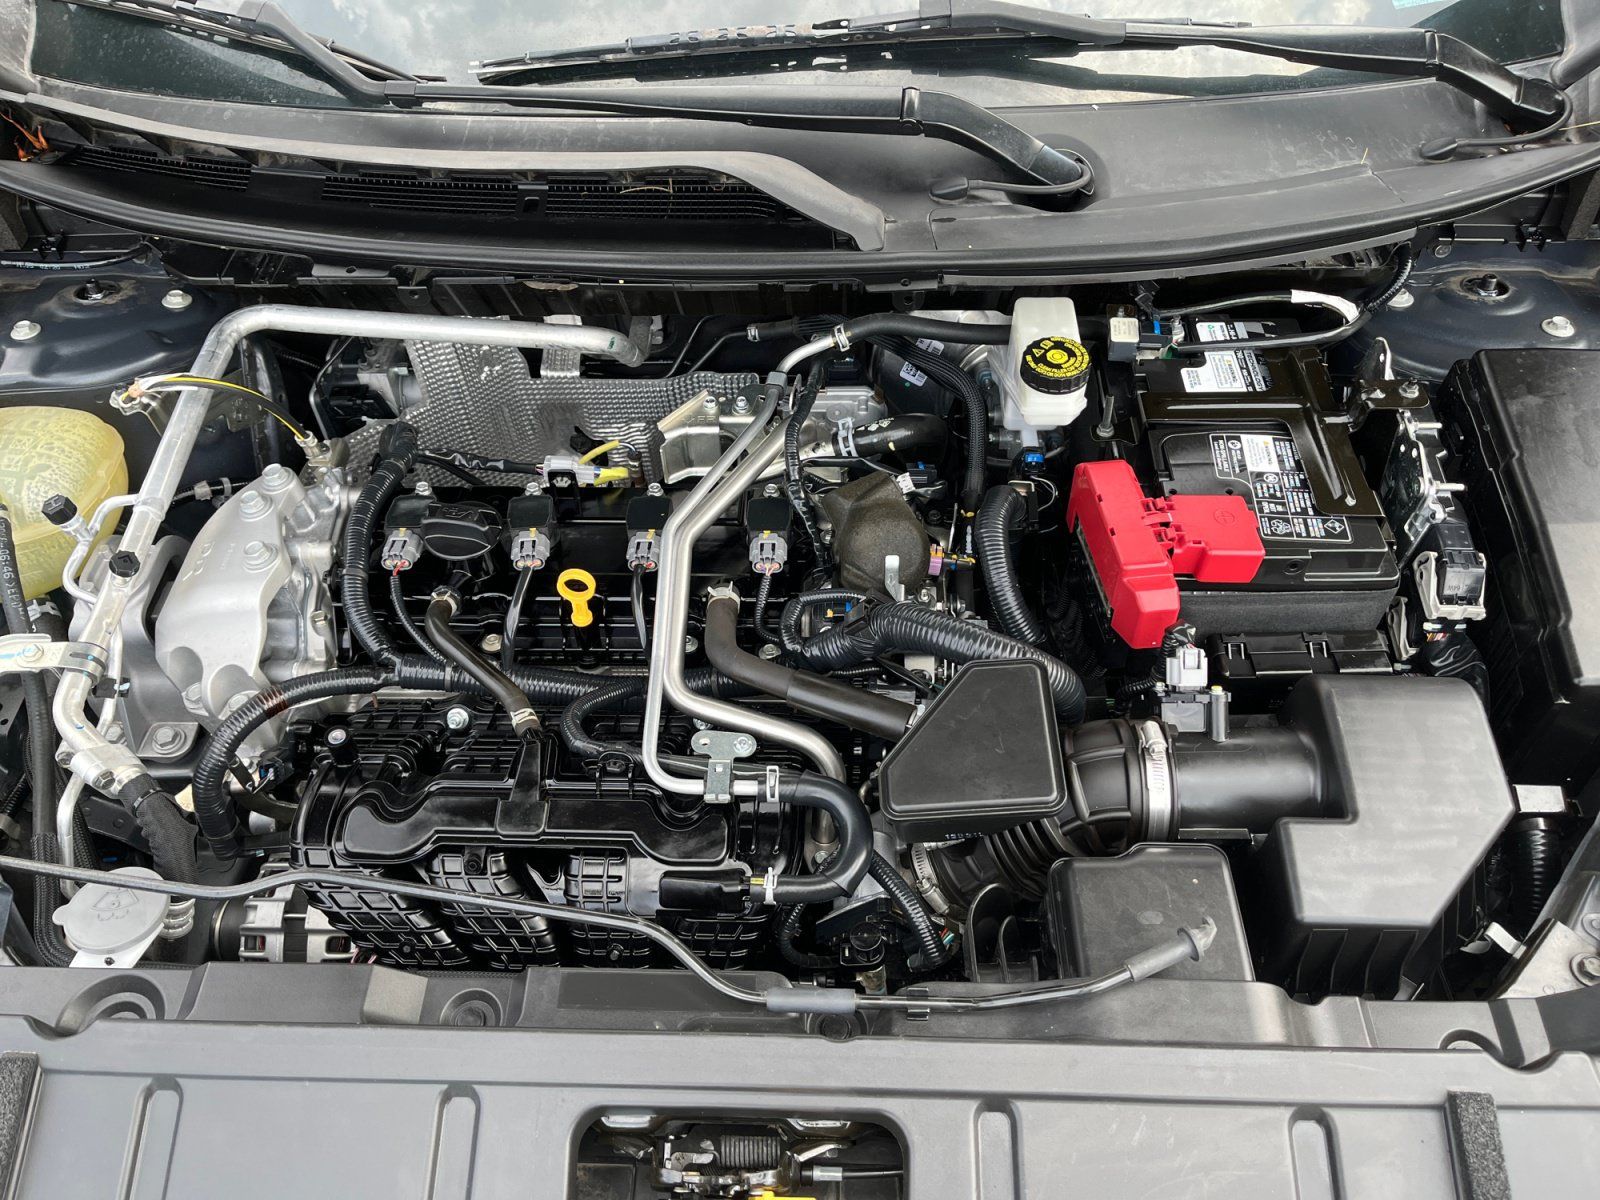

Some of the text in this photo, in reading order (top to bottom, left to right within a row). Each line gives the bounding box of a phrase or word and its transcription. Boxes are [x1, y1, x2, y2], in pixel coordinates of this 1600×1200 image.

[1247, 352, 1264, 390] TECHNOLOGY
[1218, 440, 1230, 472] NON-SPILLABLE
[1216, 458, 1224, 470] Battery
[46, 497, 61, 510] H
[1269, 503, 1277, 512] NOT
